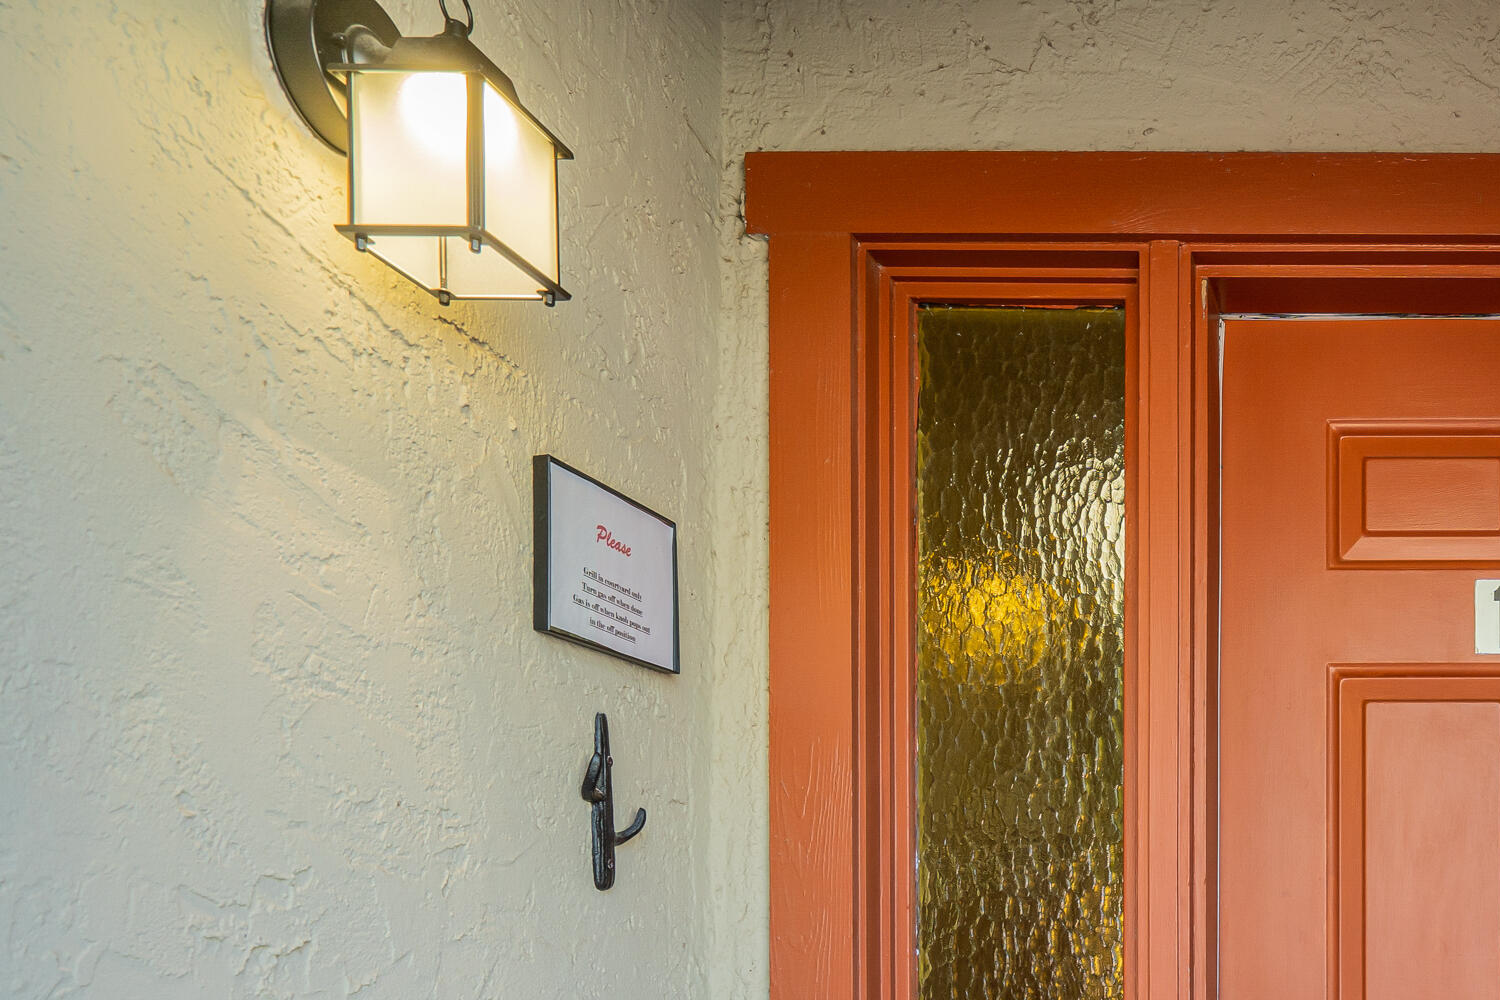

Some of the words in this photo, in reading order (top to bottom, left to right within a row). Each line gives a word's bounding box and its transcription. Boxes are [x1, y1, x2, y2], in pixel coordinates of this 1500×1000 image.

[596, 524, 632, 557] Please
[582, 581, 597, 595] Turn
[597, 590, 607, 599] gas
[607, 595, 616, 604] off
[616, 599, 630, 610] when
[631, 604, 643, 615] done
[583, 566, 597, 580] Grill
[598, 573, 604, 583] in
[632, 591, 642, 601] only
[573, 593, 584, 605] Gas
[585, 599, 591, 608] is
[591, 603, 600, 612] off
[600, 607, 615, 618] when
[615, 611, 629, 624] knob
[629, 620, 642, 631] pops
[642, 625, 651, 634] out
[589, 616, 596, 626] in
[596, 619, 605, 630] the
[606, 625, 615, 633] off
[615, 628, 636, 642] position
